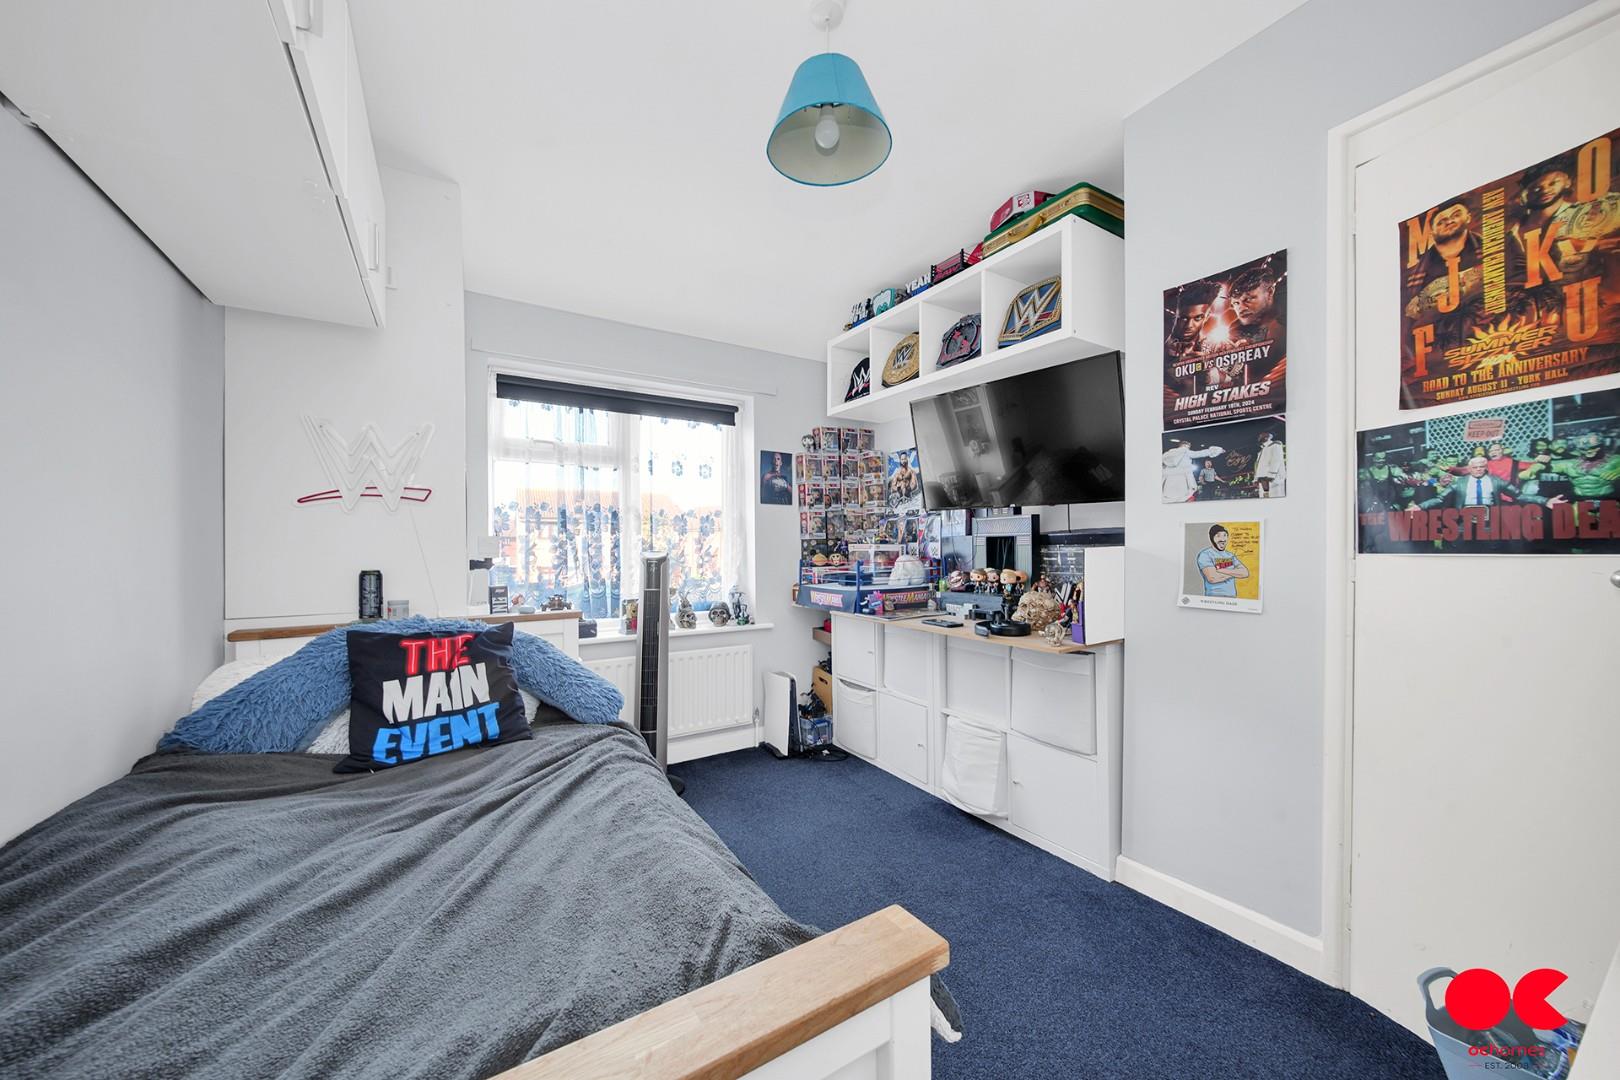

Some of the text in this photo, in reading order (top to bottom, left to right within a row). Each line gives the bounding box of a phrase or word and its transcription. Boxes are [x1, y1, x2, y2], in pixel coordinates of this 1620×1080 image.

[905, 273, 931, 293] YEAH
[1444, 325, 1558, 359] SUMMER
[1447, 336, 1553, 370] SIZZLER
[1175, 363, 1196, 378] OKU
[1204, 359, 1214, 369] VS
[1216, 345, 1271, 369] OSPREAY
[1422, 376, 1449, 393] ROAD
[1452, 373, 1467, 386] TO
[1470, 366, 1494, 383] THE
[1498, 347, 1589, 377] ANNIVERSARY
[1173, 380, 1272, 412] HIGH STAKES
[1436, 388, 1465, 401] SUNDAY
[1467, 382, 1497, 395] AUGUST
[1517, 372, 1541, 385] YORK
[1544, 367, 1569, 380] HALL
[1173, 417, 1192, 425] CRYSTAL
[1387, 503, 1545, 542] WRESTLING
[399, 632, 477, 675] THE
[382, 662, 491, 724] MAIN
[372, 702, 500, 764] EVENT
